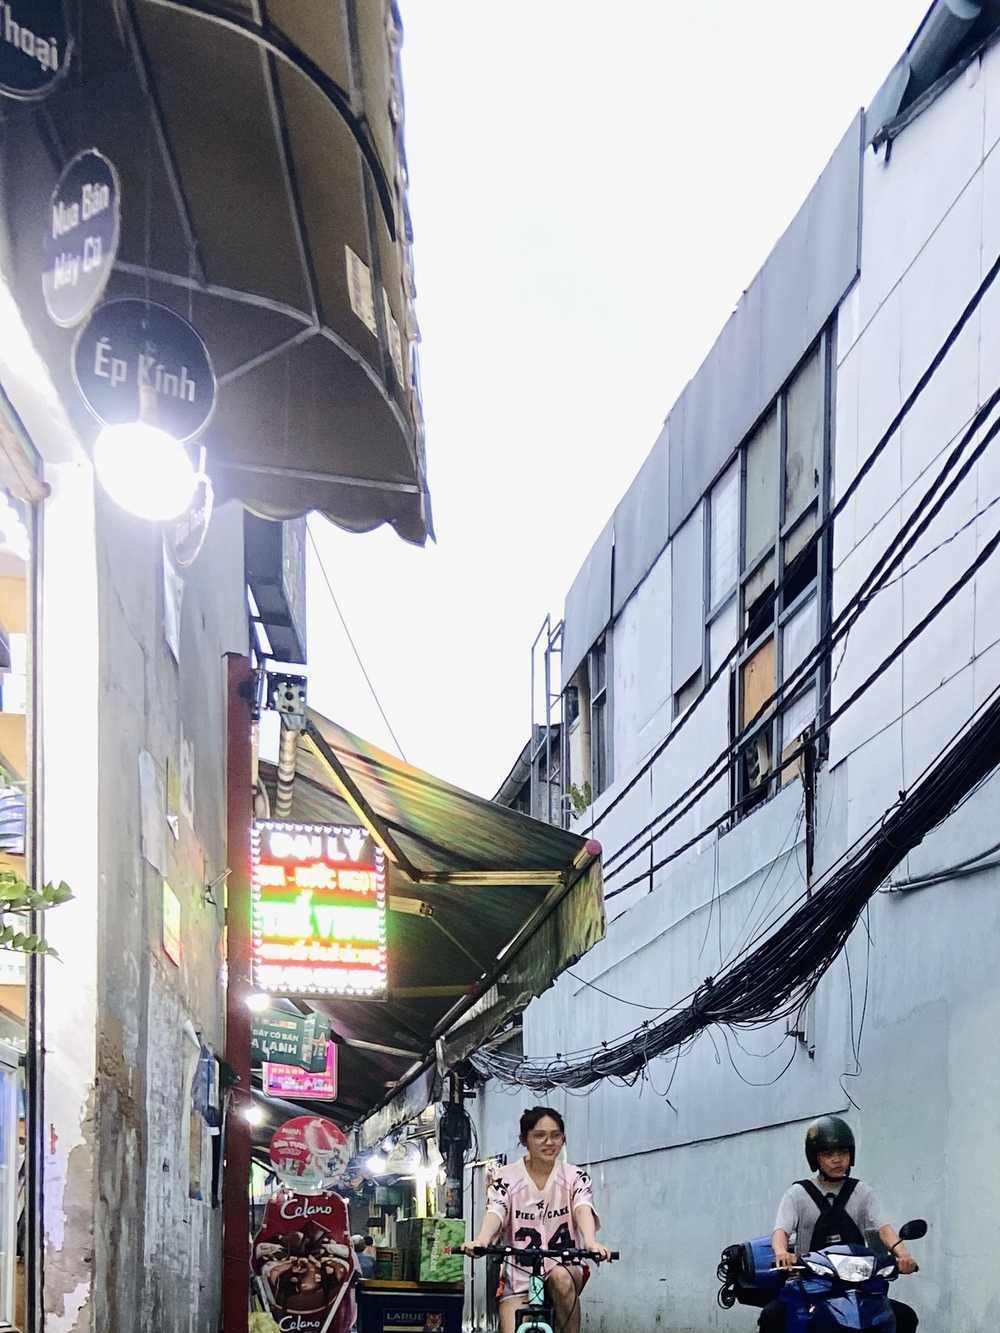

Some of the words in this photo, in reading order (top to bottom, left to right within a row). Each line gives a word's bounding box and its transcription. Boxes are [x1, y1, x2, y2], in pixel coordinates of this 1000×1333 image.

[52, 201, 80, 239] Mua
[81, 182, 110, 221] Bán
[53, 252, 81, 290] Máy
[94, 336, 127, 388] Ép
[137, 352, 196, 403] Kính
[269, 1031, 281, 1039] CÓ
[281, 1033, 299, 1042] BÁN
[261, 1039, 297, 1057] LẠNH
[279, 1197, 333, 1220] Celano
[547, 1205, 570, 1219] CAKE
[278, 1314, 321, 1333] Celano
[386, 1312, 425, 1321] LARUE
